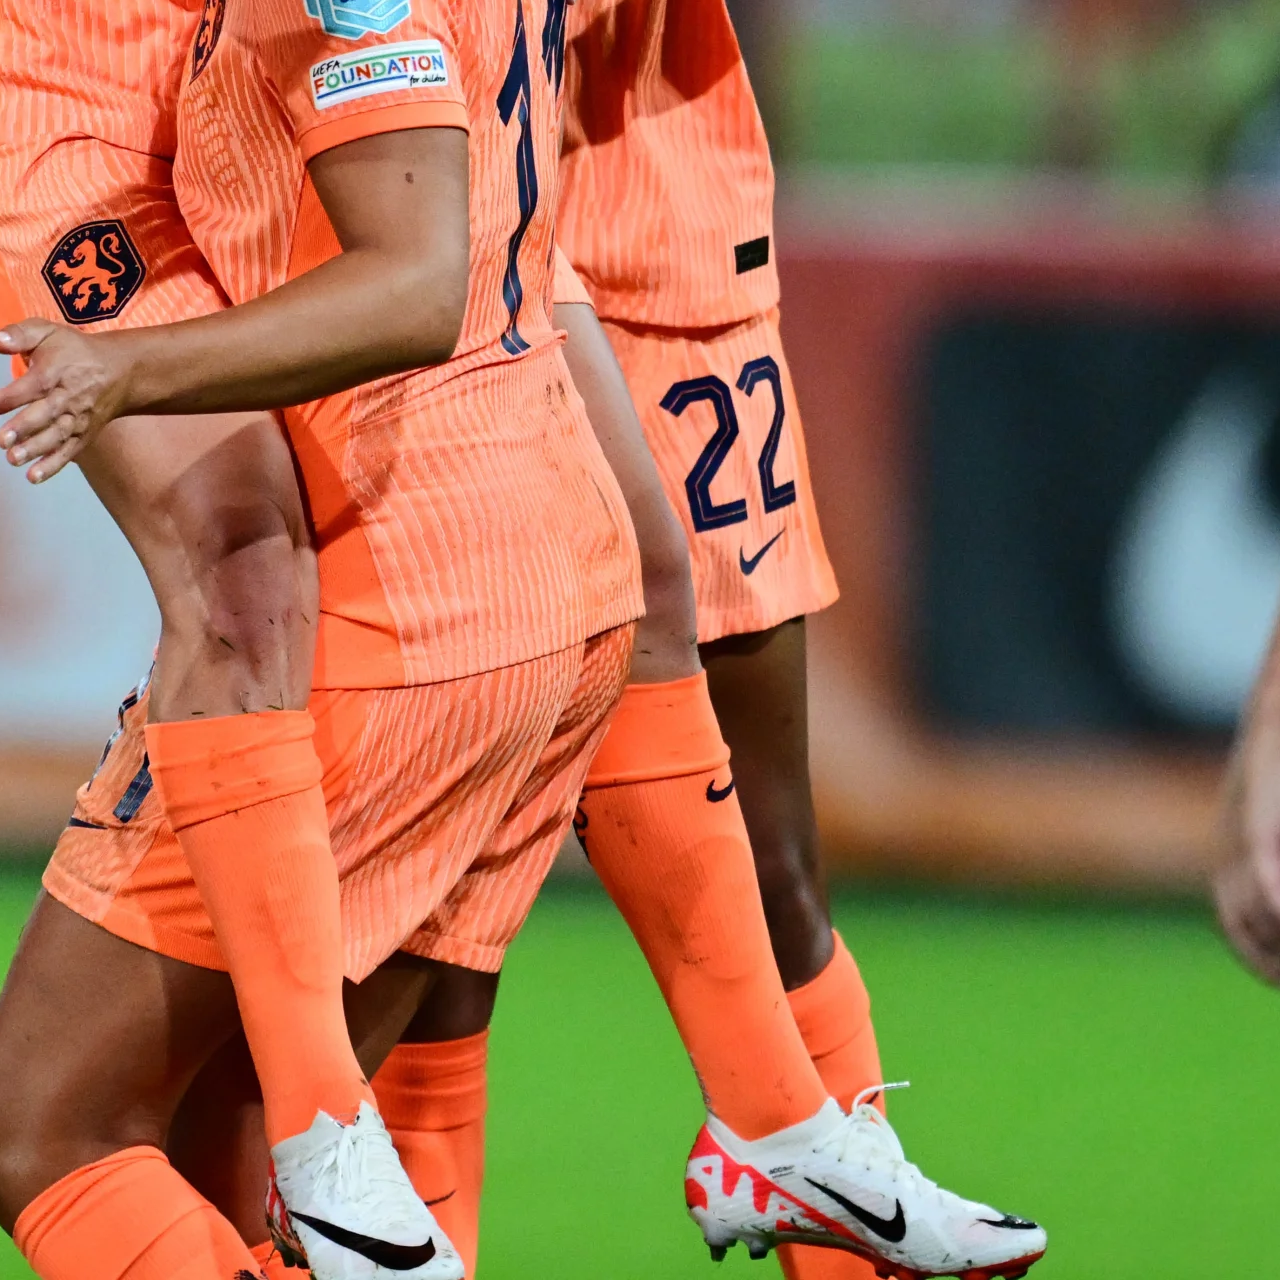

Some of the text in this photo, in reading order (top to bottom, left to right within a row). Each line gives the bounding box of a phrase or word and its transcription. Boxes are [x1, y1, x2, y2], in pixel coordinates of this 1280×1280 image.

[312, 59, 341, 78] UEFA
[410, 74, 420, 87] for
[659, 355, 797, 533] 22
